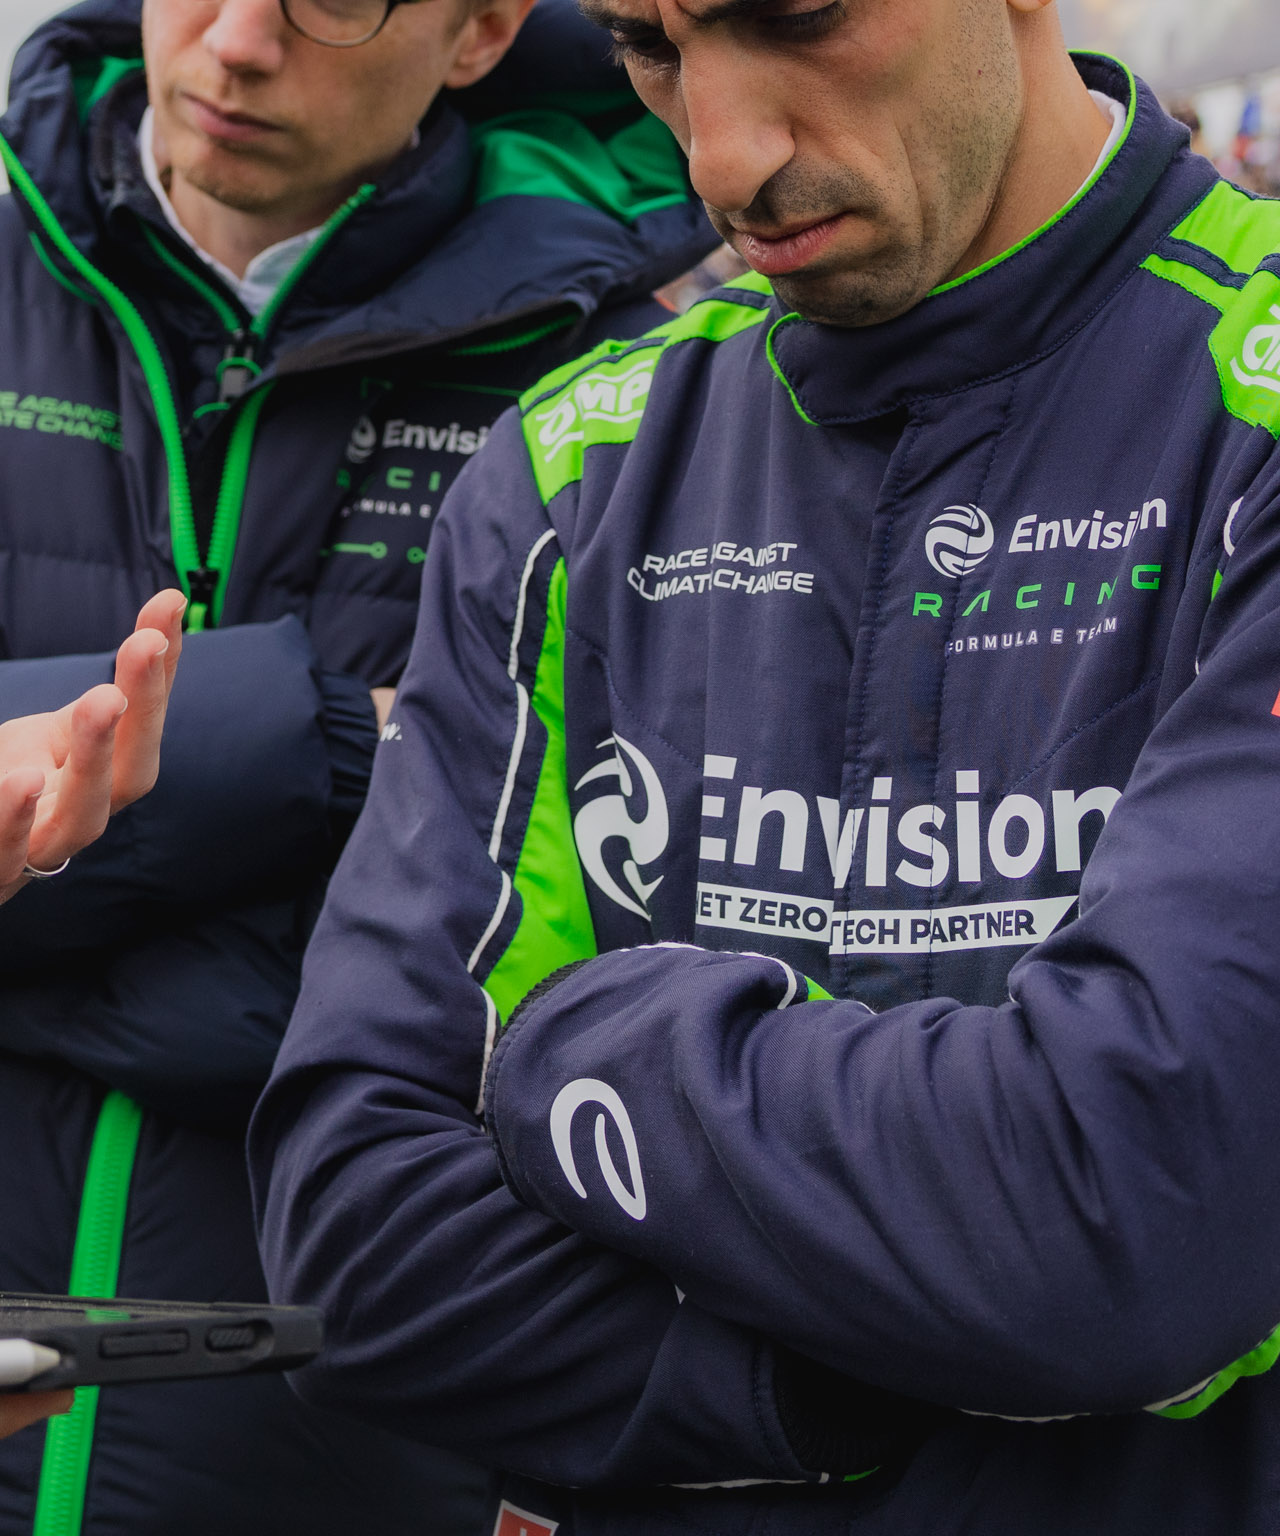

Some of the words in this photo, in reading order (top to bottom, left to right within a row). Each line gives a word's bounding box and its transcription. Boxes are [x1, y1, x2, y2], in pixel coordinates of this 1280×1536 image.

[18, 394, 122, 429] AGAINS
[35, 414, 125, 452] CHANG
[382, 418, 492, 456] Envisi
[642, 547, 709, 576] RACE
[626, 567, 713, 602] CLIMAT
[912, 564, 1162, 618] RACING
[1052, 628, 1063, 644] E
[1077, 616, 1118, 644] TEAM
[699, 754, 1124, 889] Envision
[696, 890, 732, 918] ET
[738, 896, 829, 933] ZERO
[830, 918, 901, 947] TECH
[909, 908, 1038, 946] PARTNER
